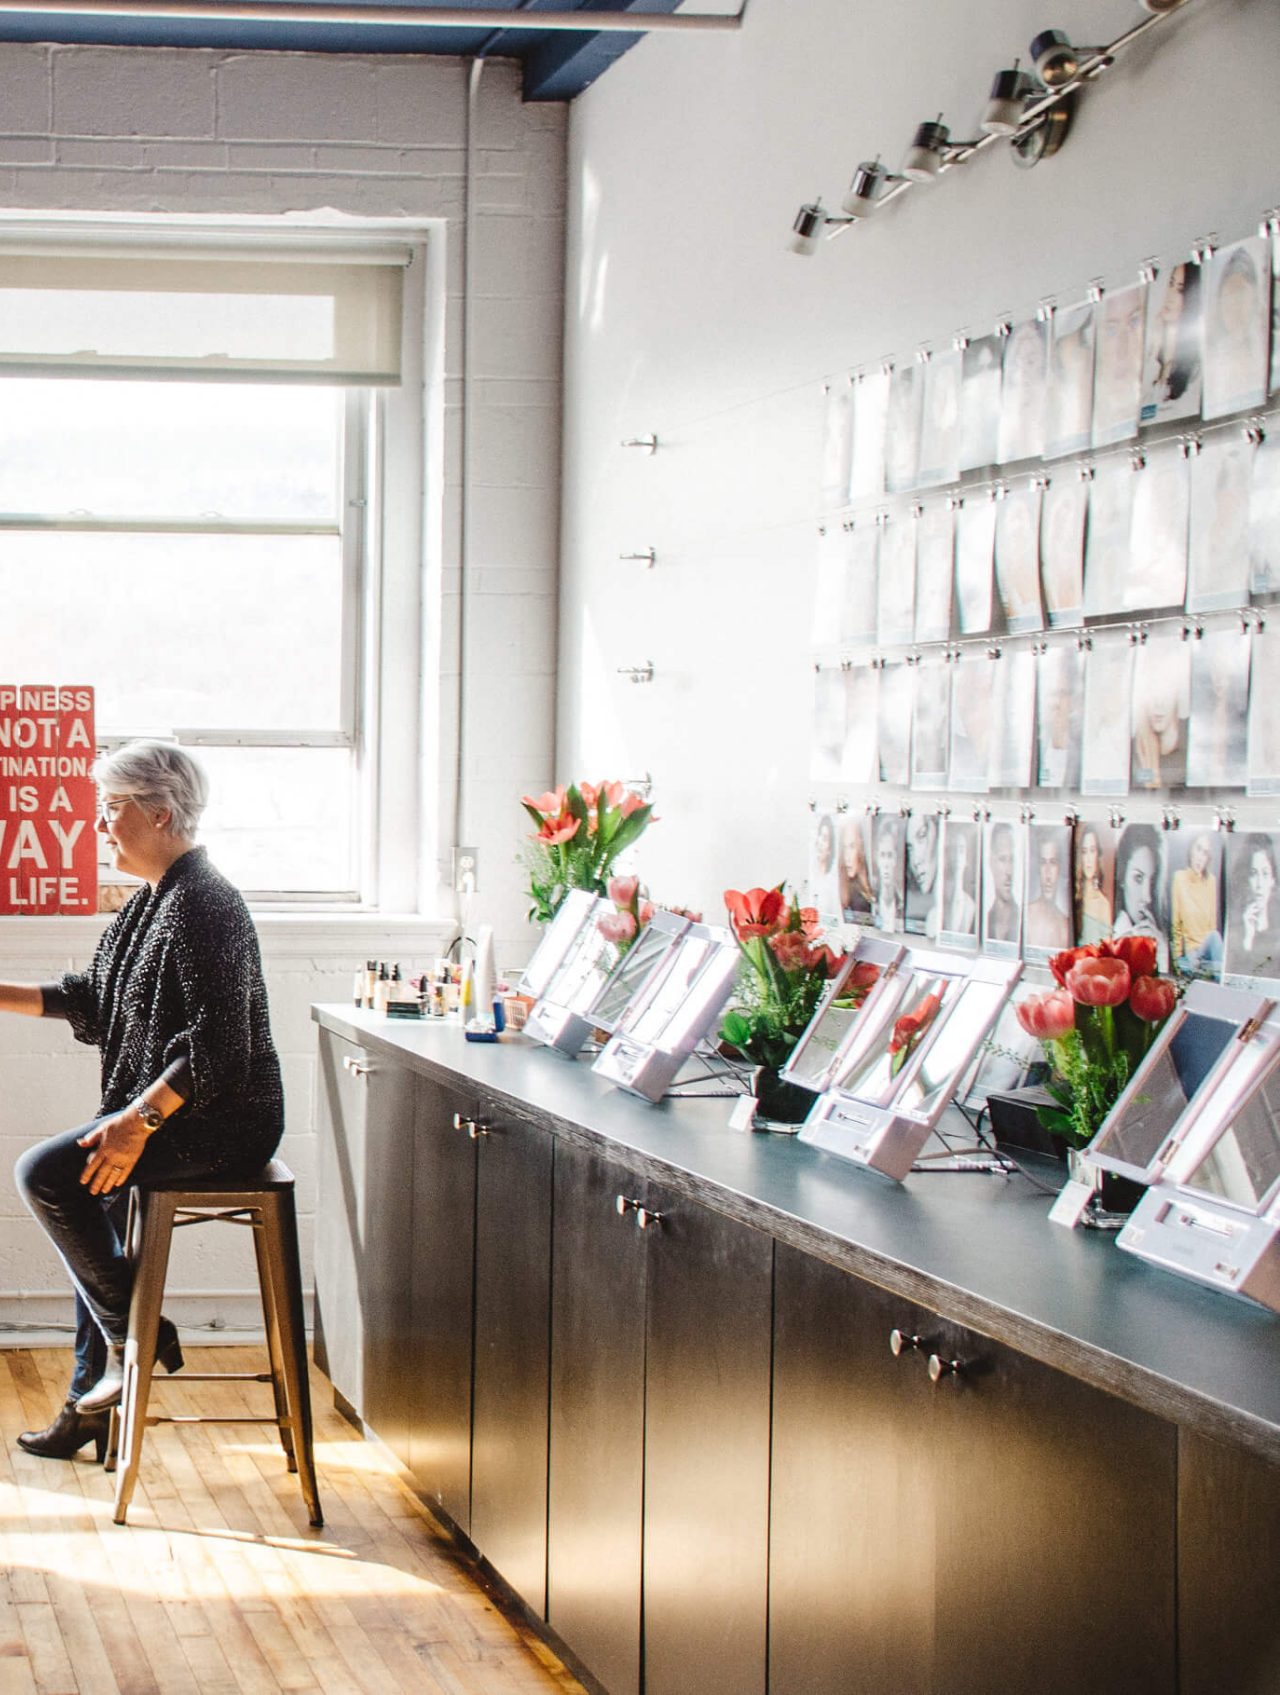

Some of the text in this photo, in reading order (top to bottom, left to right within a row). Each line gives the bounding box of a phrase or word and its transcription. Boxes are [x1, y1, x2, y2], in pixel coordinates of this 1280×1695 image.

[66, 719, 91, 748] A
[9, 786, 39, 812] IS
[49, 787, 73, 812] A
[9, 878, 89, 905] LIFE.
